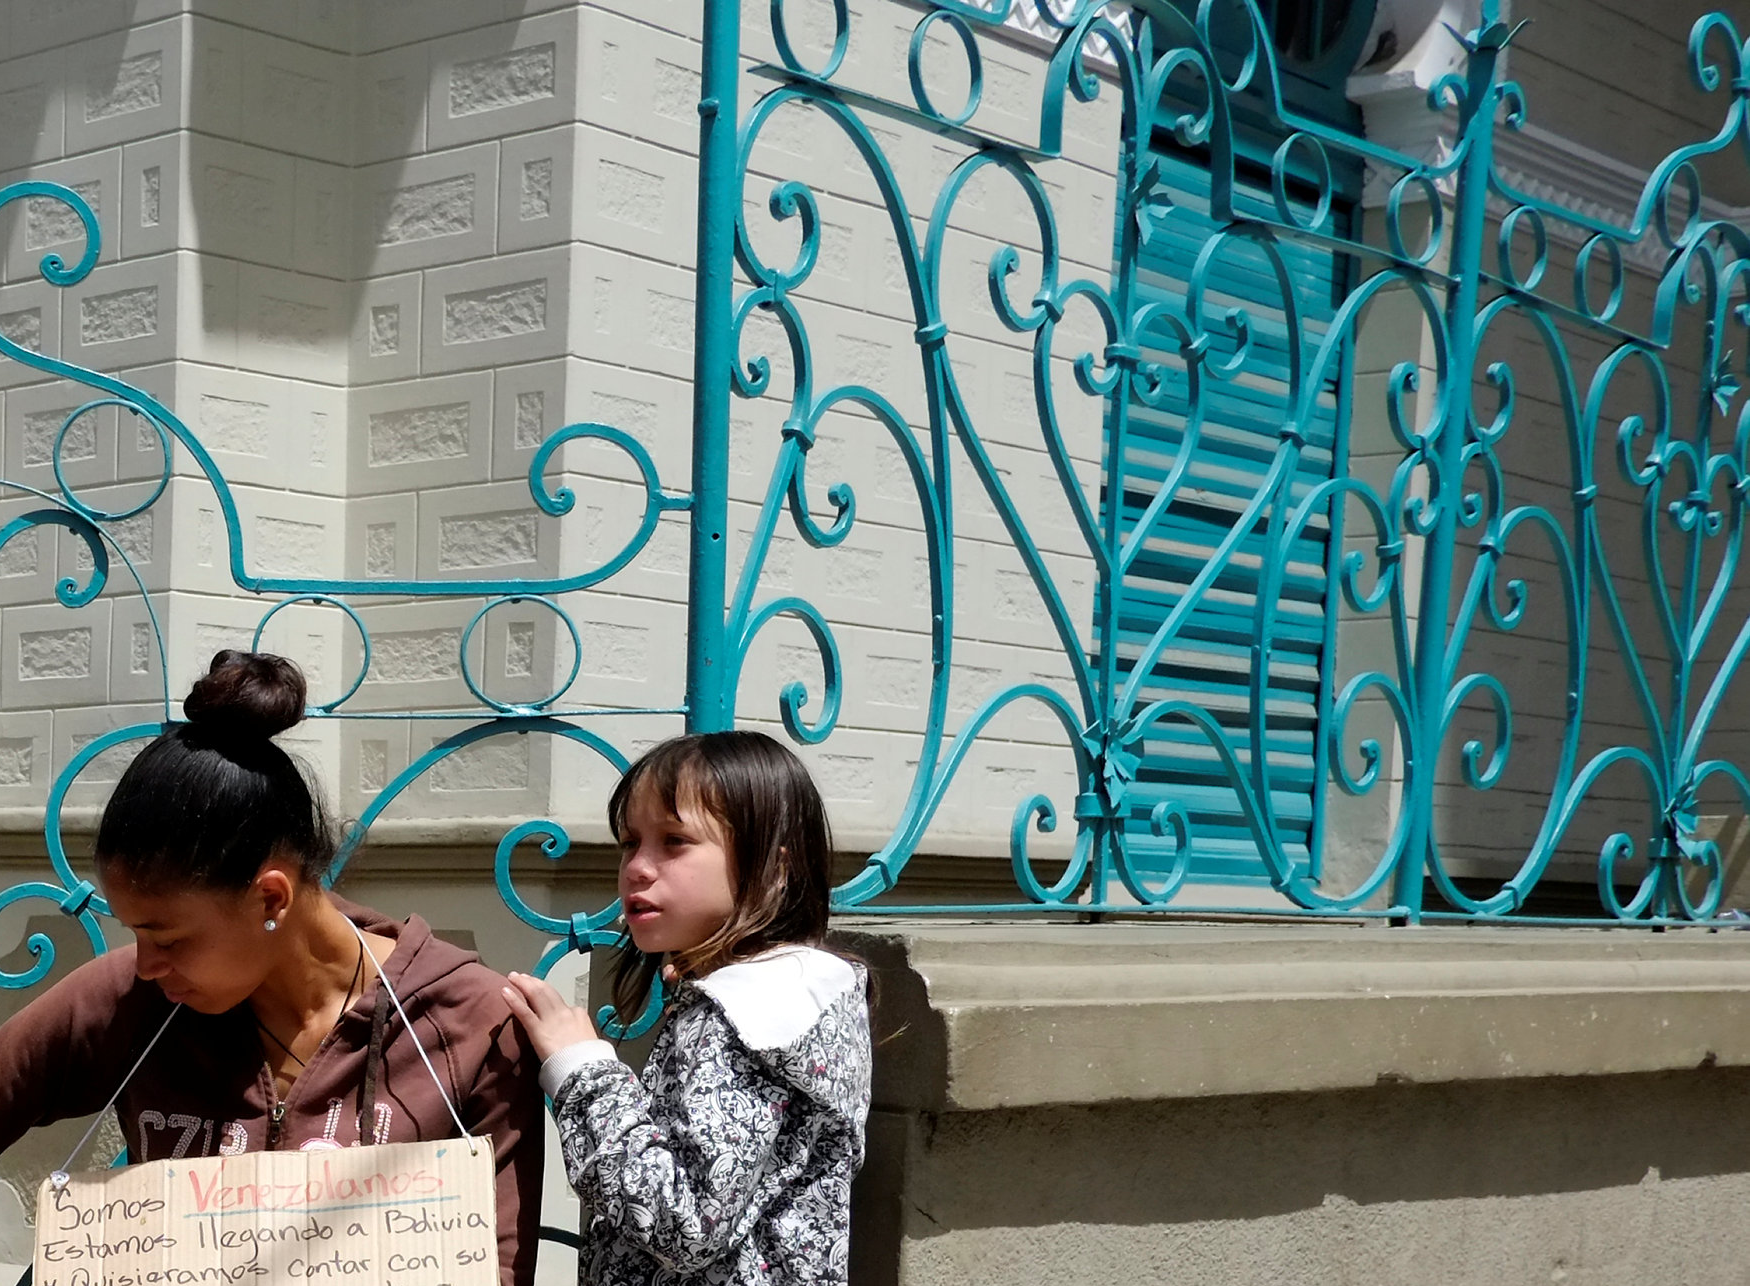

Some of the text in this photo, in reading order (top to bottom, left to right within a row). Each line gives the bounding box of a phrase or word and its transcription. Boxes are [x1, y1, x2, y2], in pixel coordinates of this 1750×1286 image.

[55, 1187, 165, 1230] Somos
[42, 1207, 489, 1263] Estamos llegando a Bolivia
[456, 1247, 487, 1266] su
